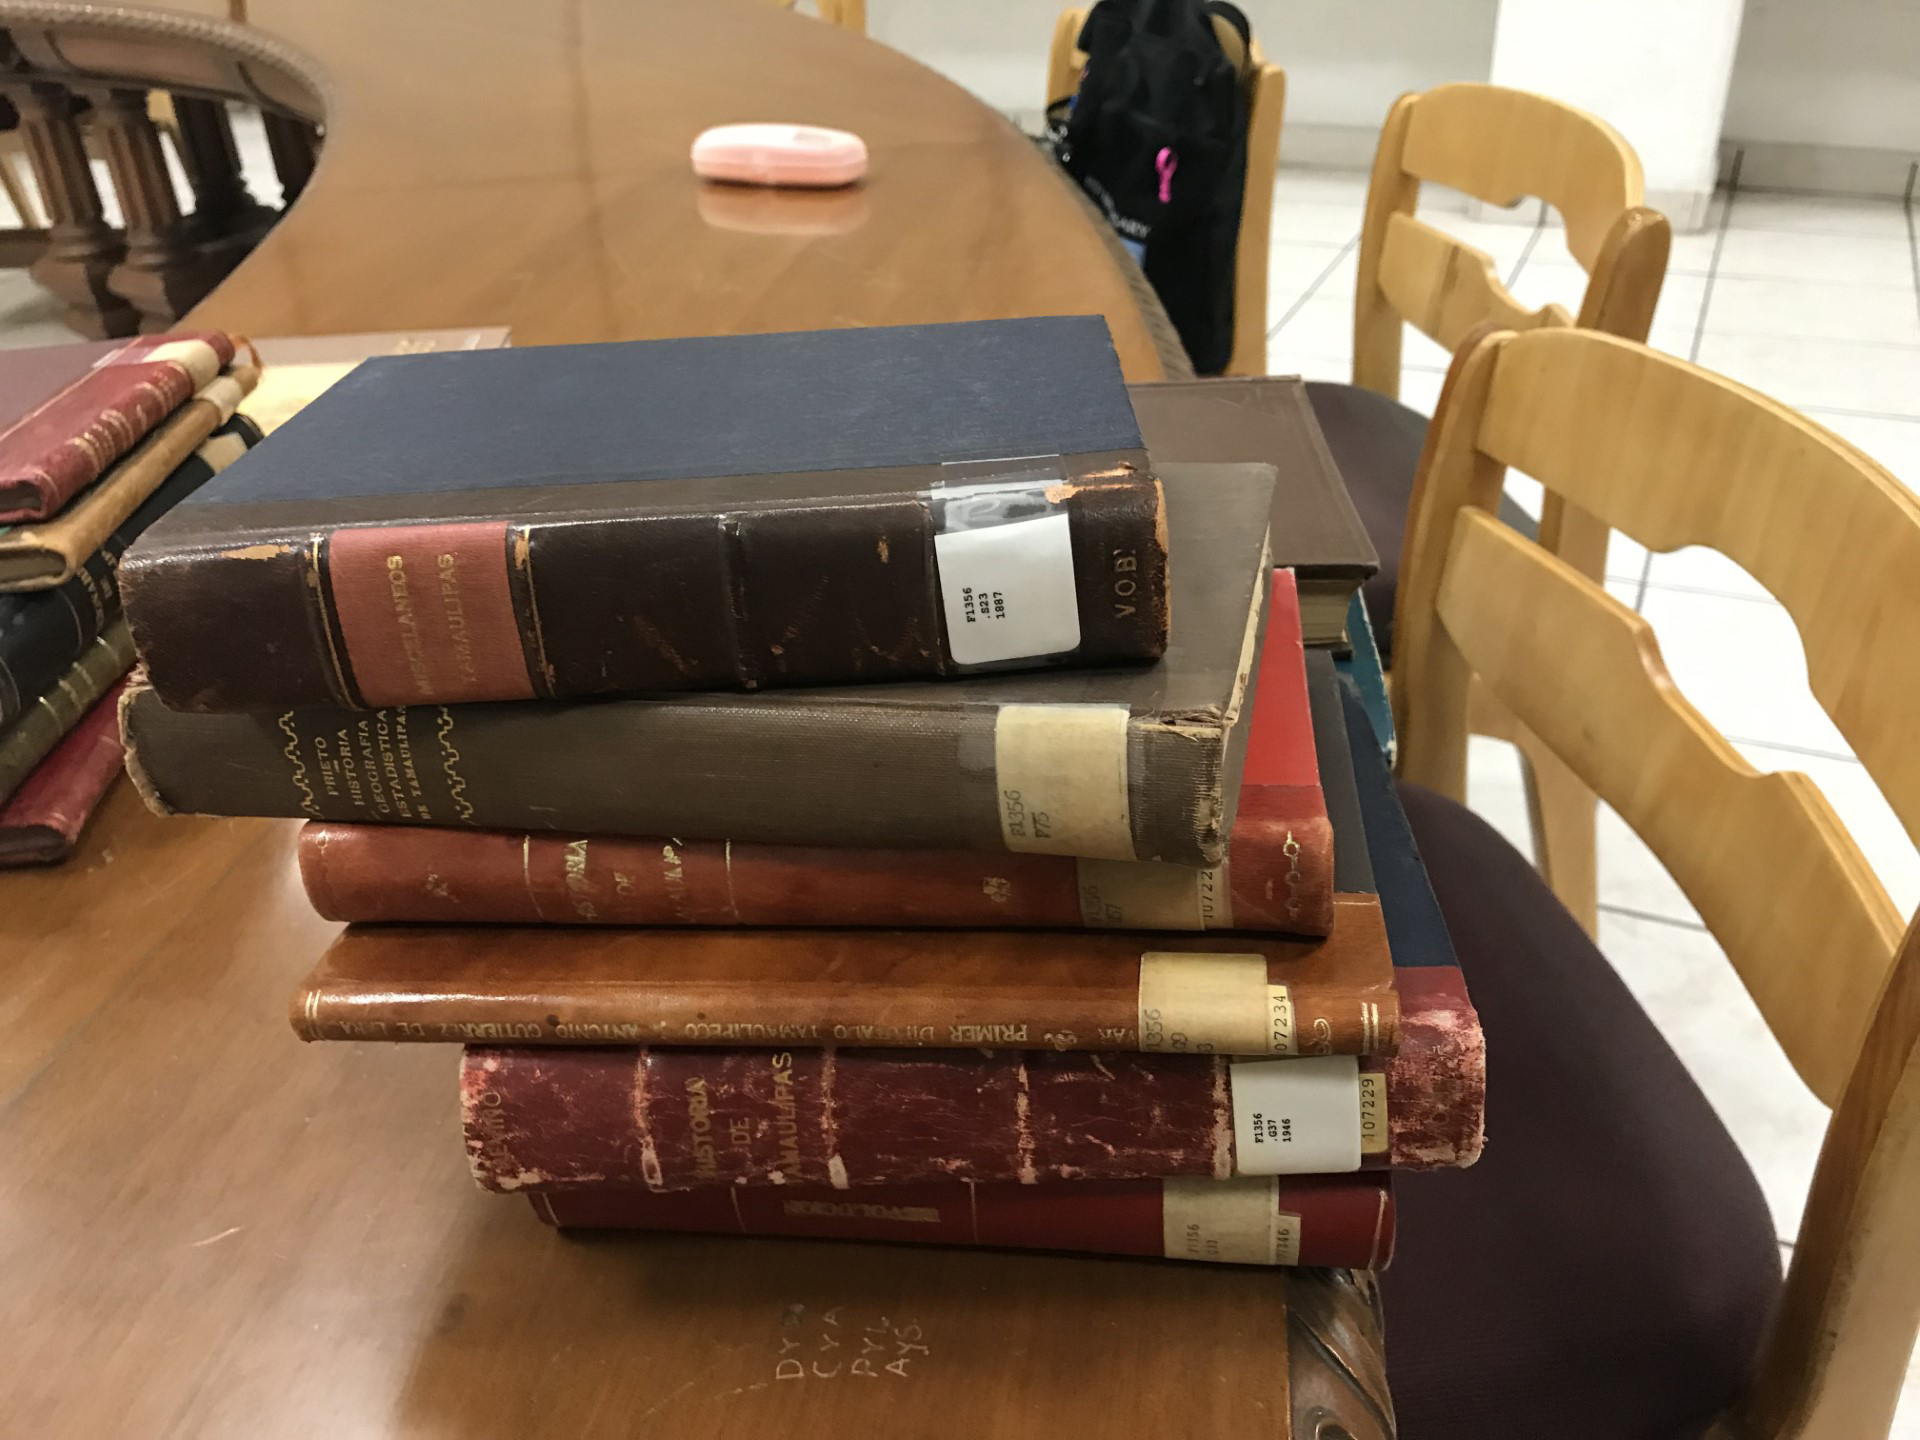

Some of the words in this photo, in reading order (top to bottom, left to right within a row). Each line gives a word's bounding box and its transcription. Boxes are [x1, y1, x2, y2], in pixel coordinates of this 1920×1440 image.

[962, 587, 976, 623] F1356
[979, 593, 991, 619] .S23
[993, 591, 1005, 619] 1887
[315, 737, 340, 796] PRIETO
[337, 729, 366, 806] HISTORIA
[358, 721, 391, 813] GEOGRAFIA
[376, 710, 412, 817] ESTADISTICA
[949, 1023, 1028, 1042] PRIMER
[1361, 1079, 1375, 1139] 107229
[683, 1077, 718, 1177] HISTORIA
[729, 1117, 752, 1146] DE
[1253, 1113, 1264, 1143] F1356
[1268, 1120, 1278, 1142] .G37
[1282, 1118, 1292, 1142] 1946
